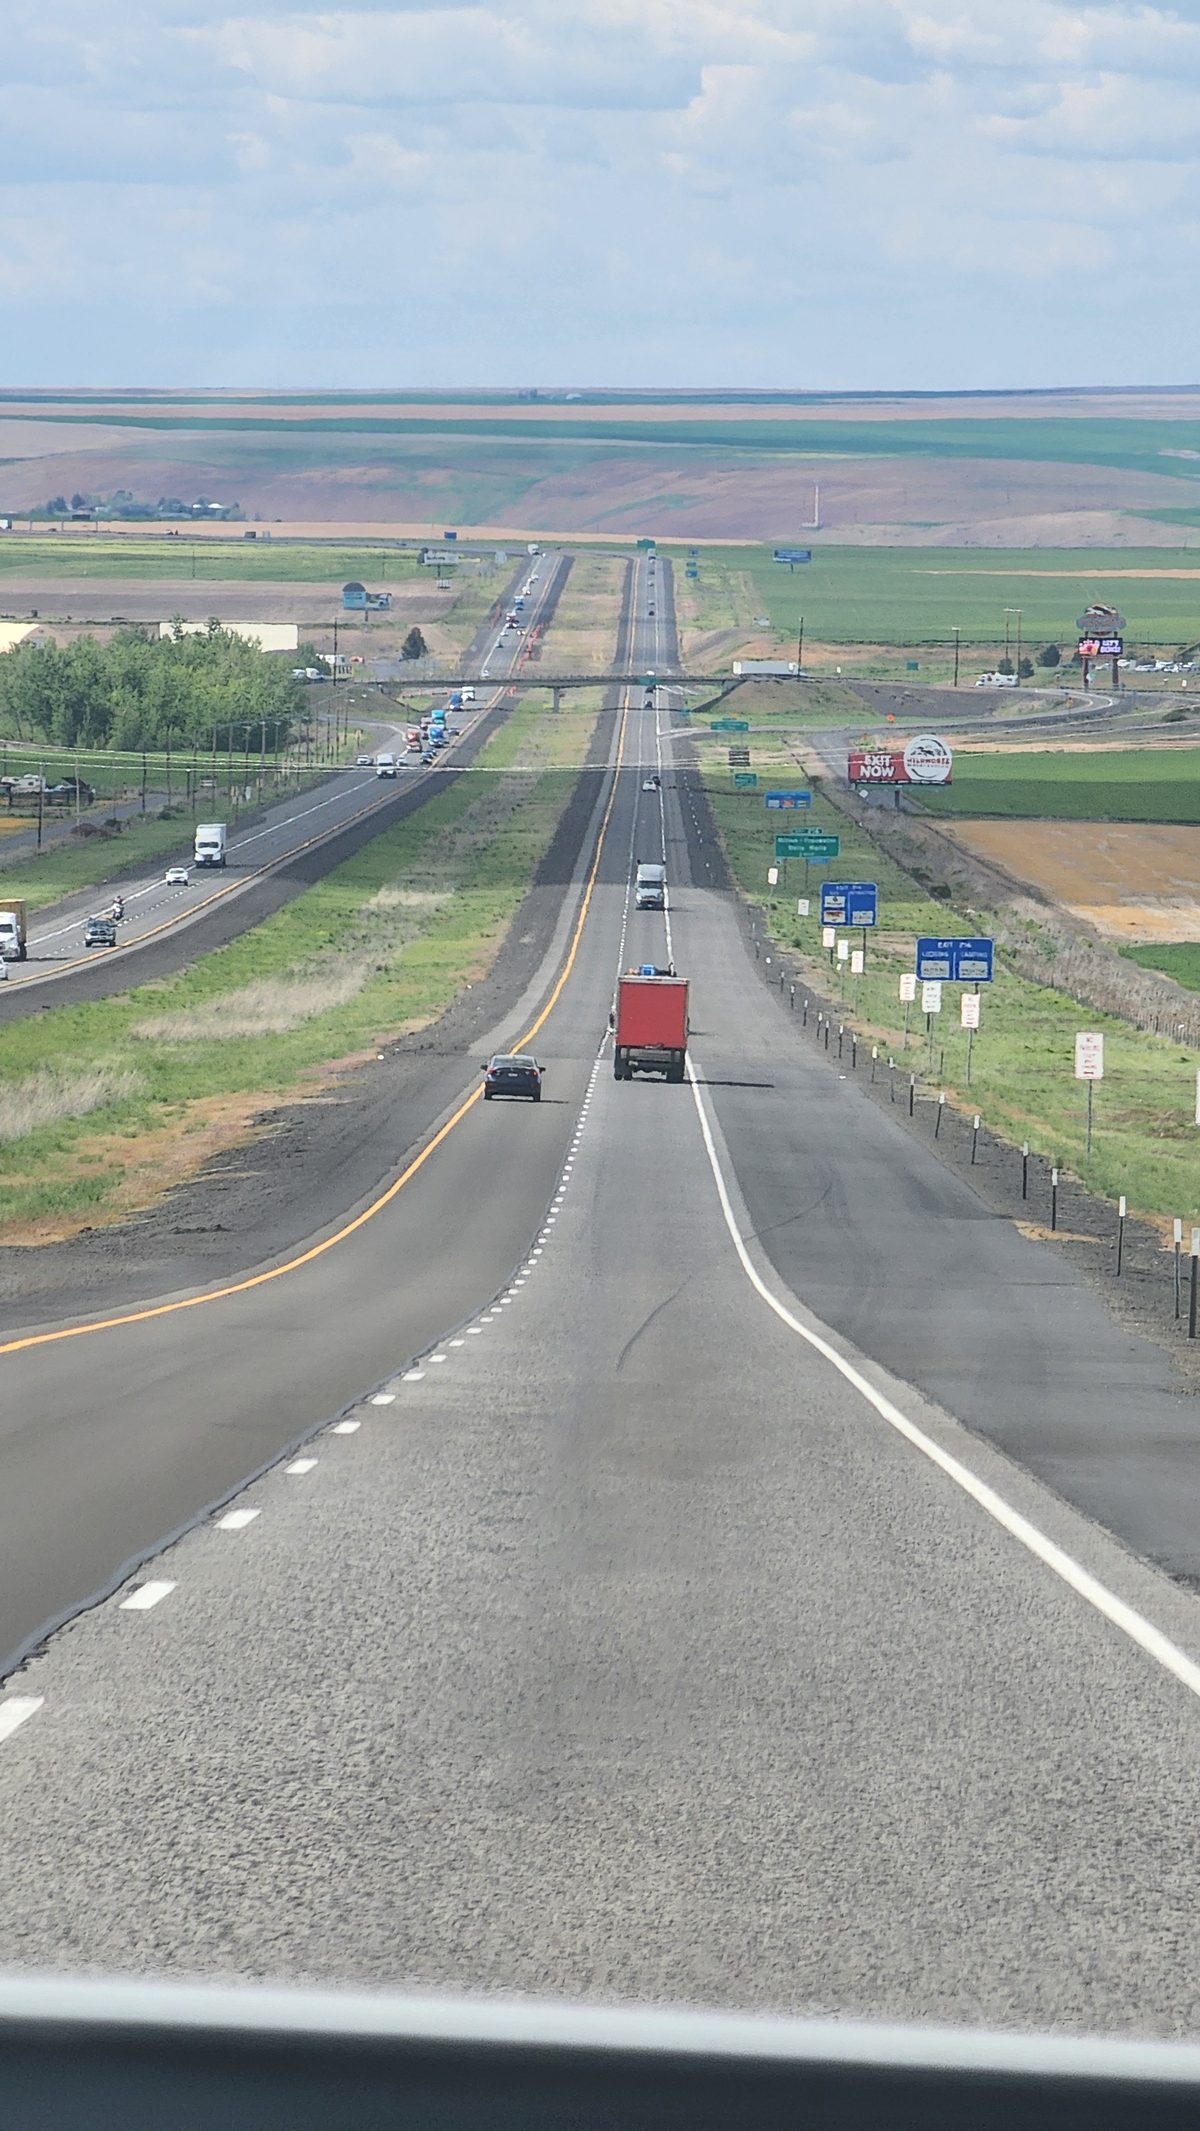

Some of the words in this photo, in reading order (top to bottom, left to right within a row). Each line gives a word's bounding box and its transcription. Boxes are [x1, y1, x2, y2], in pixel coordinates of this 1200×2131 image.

[864, 755, 891, 766] EXIT
[860, 765, 895, 778] NOW
[937, 941, 953, 949] EXIT
